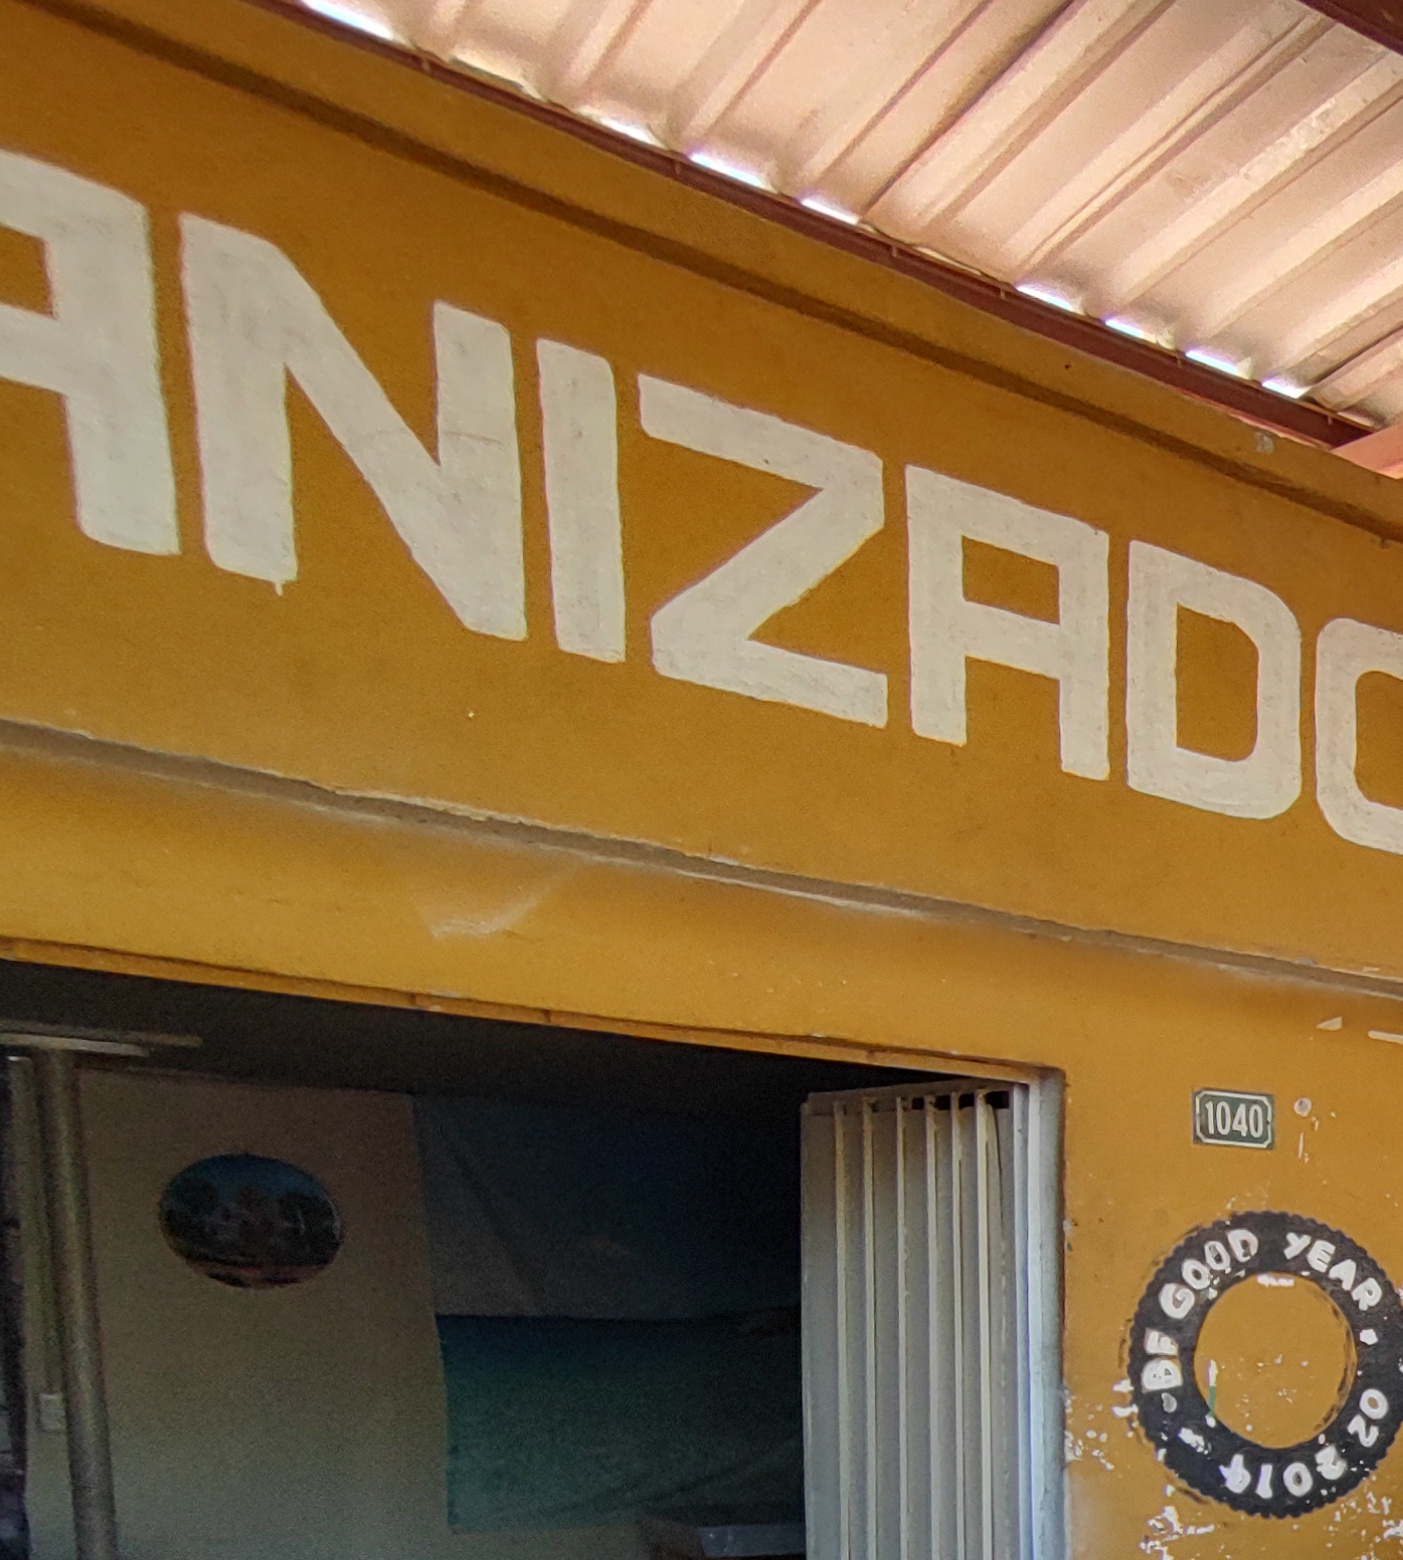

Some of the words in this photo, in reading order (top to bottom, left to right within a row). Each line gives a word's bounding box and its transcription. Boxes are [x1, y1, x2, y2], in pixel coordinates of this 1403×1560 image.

[1205, 1101, 1264, 1138] 1040
[1159, 1229, 1259, 1320] GOOD
[1284, 1232, 1383, 1311] YEAR
